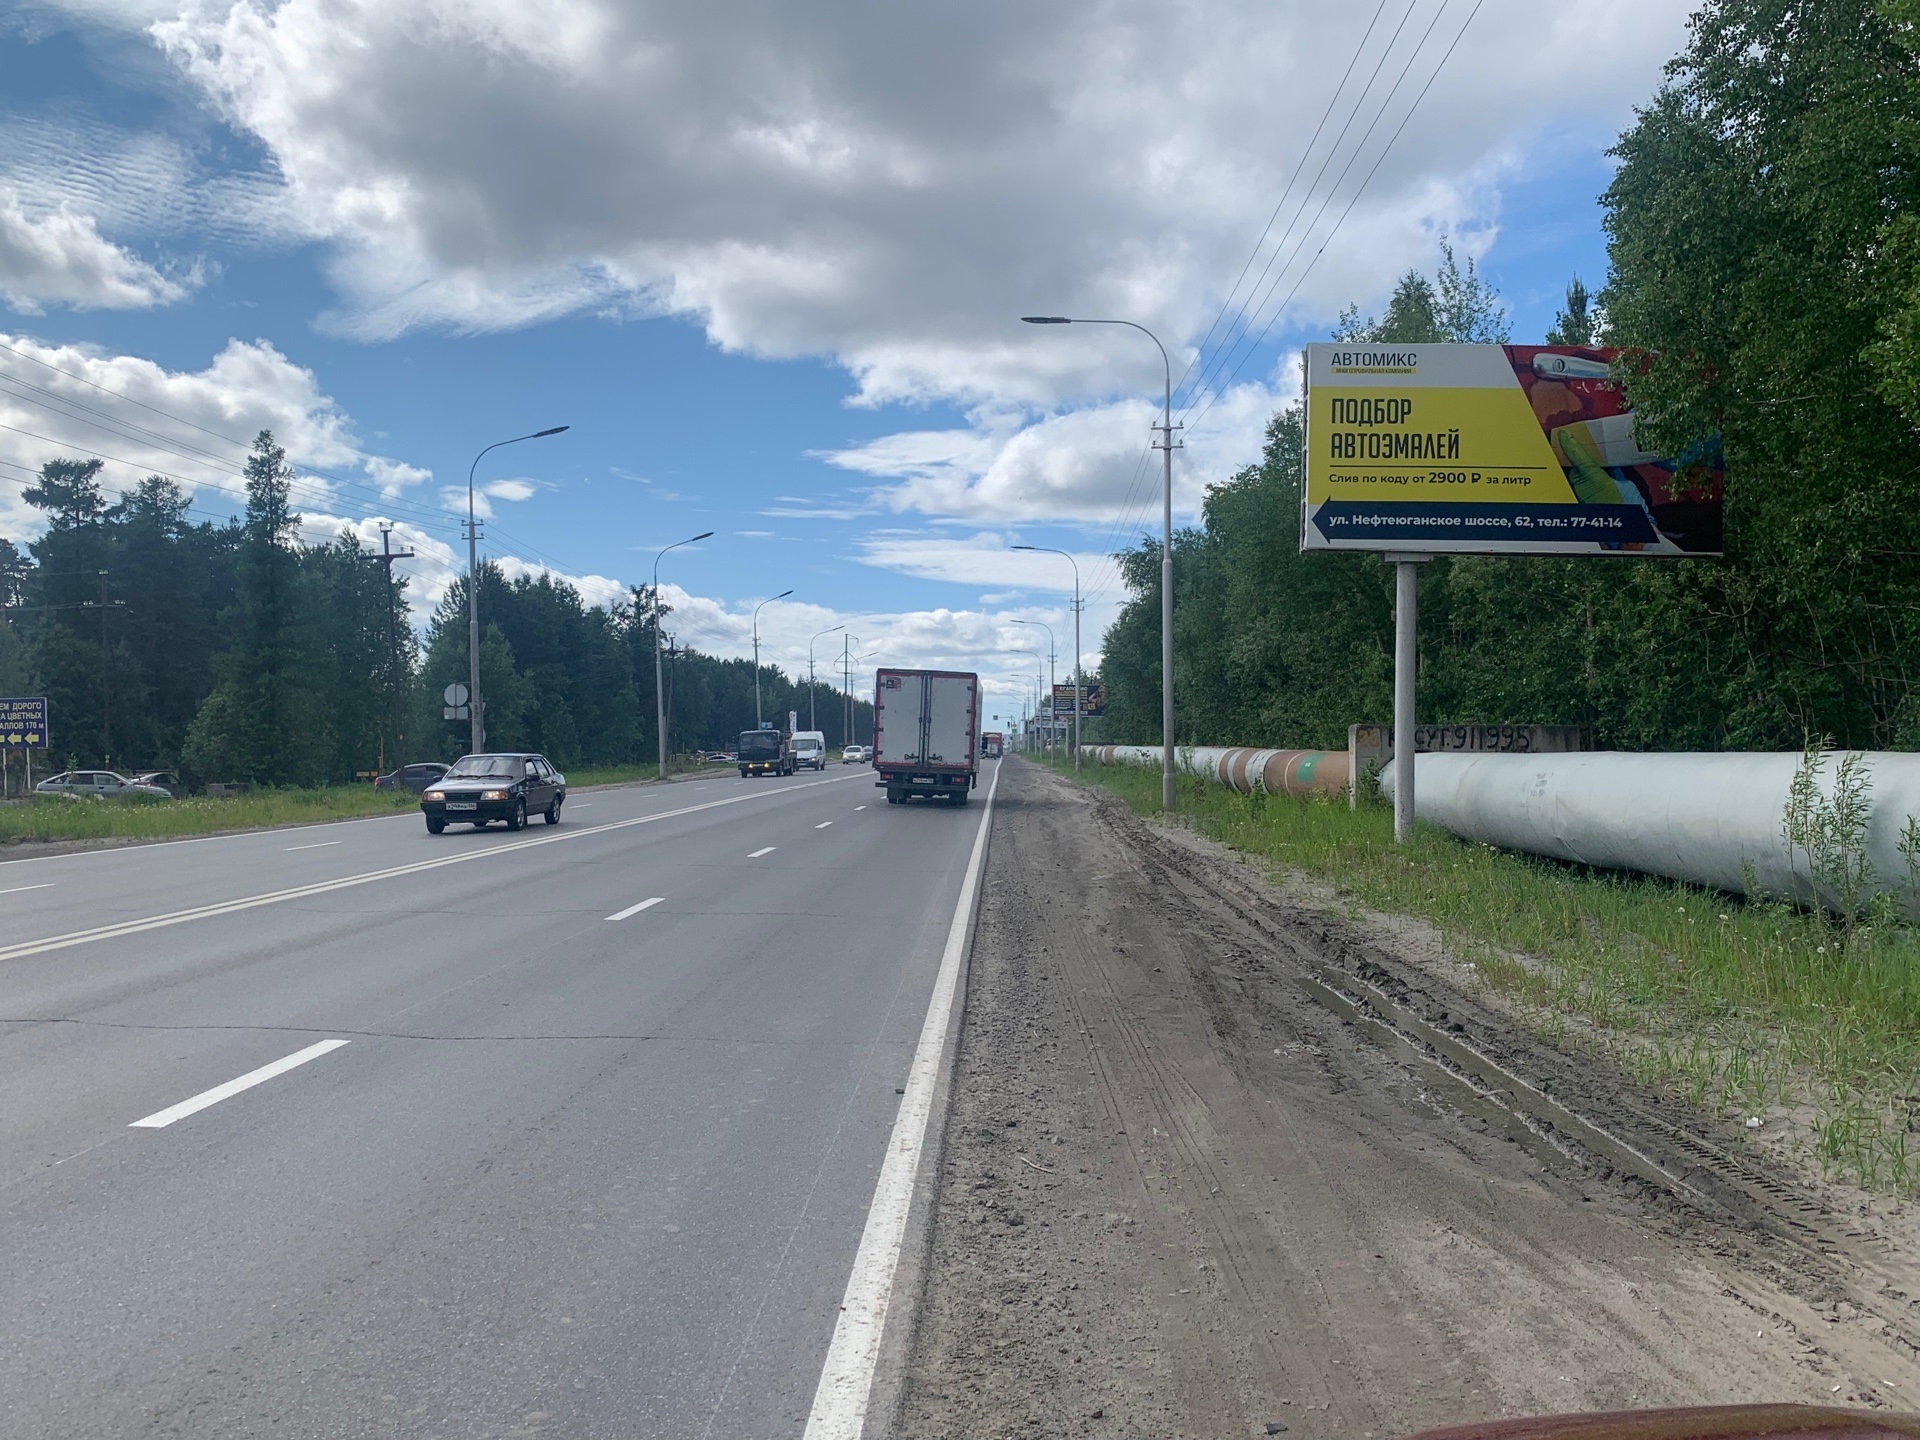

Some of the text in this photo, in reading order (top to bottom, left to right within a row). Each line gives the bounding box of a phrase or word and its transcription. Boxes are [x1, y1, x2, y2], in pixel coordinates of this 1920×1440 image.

[1331, 352, 1417, 366] АВТОМИКС
[1331, 398, 1412, 428] ПОДБОР
[1331, 429, 1460, 460] АВТОЭМАЛЕЙ
[1328, 474, 1359, 483] Слив
[1362, 475, 1377, 483] по
[1380, 475, 1409, 485] коду
[1412, 475, 1426, 484] от
[1428, 472, 1467, 484] 2900
[1485, 477, 1500, 485] за
[1502, 477, 1532, 487] литр
[1329, 514, 1622, 528] ул. Нефтеюганское шоссе, 62, тел.: 77-41-14
[12, 702, 42, 711] ДОРОГО
[7, 712, 42, 721] ЦВЕТНЫХ
[26, 721, 37, 729] 170
